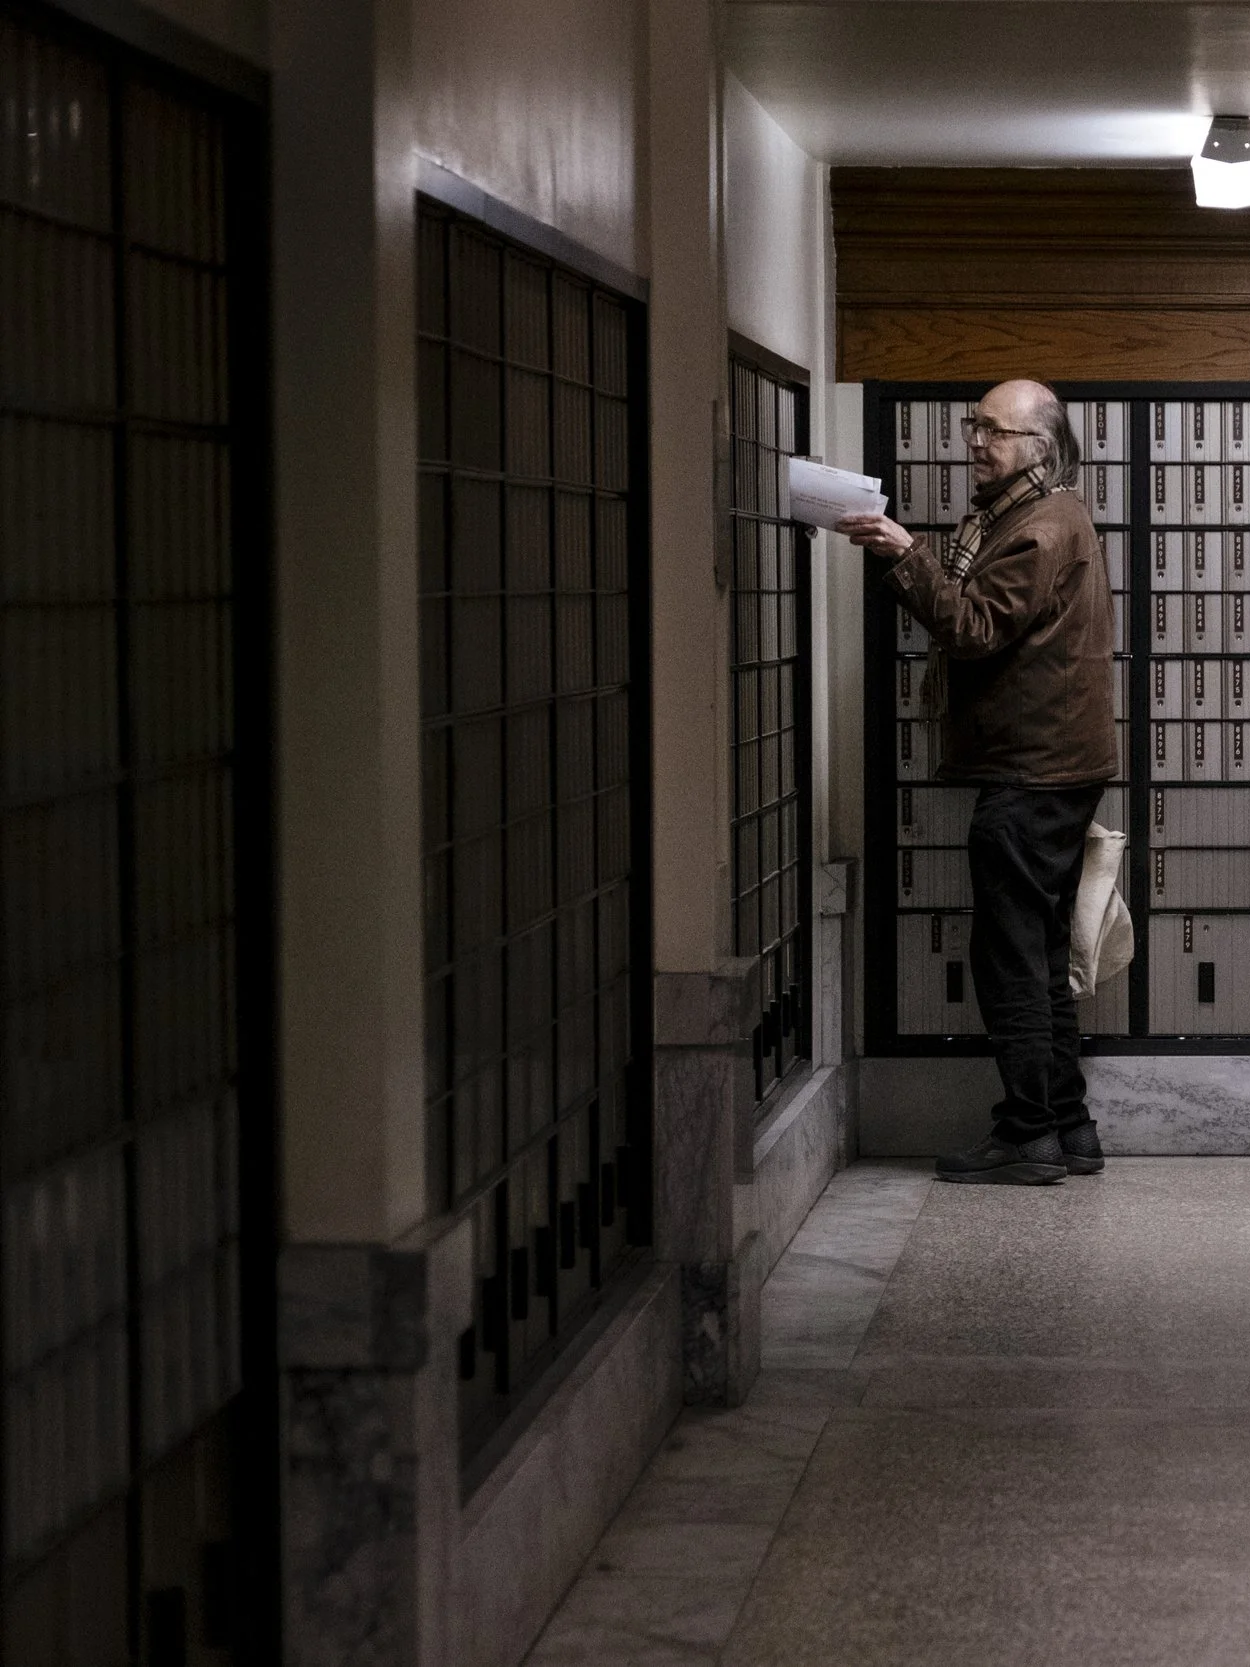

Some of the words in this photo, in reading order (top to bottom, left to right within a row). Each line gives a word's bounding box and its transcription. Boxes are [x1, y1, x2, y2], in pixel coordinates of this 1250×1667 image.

[1156, 664, 1164, 693] 8495
[1156, 726, 1164, 756] 8496
[1234, 726, 1242, 755] 8476
[1184, 920, 1192, 948] 8479
